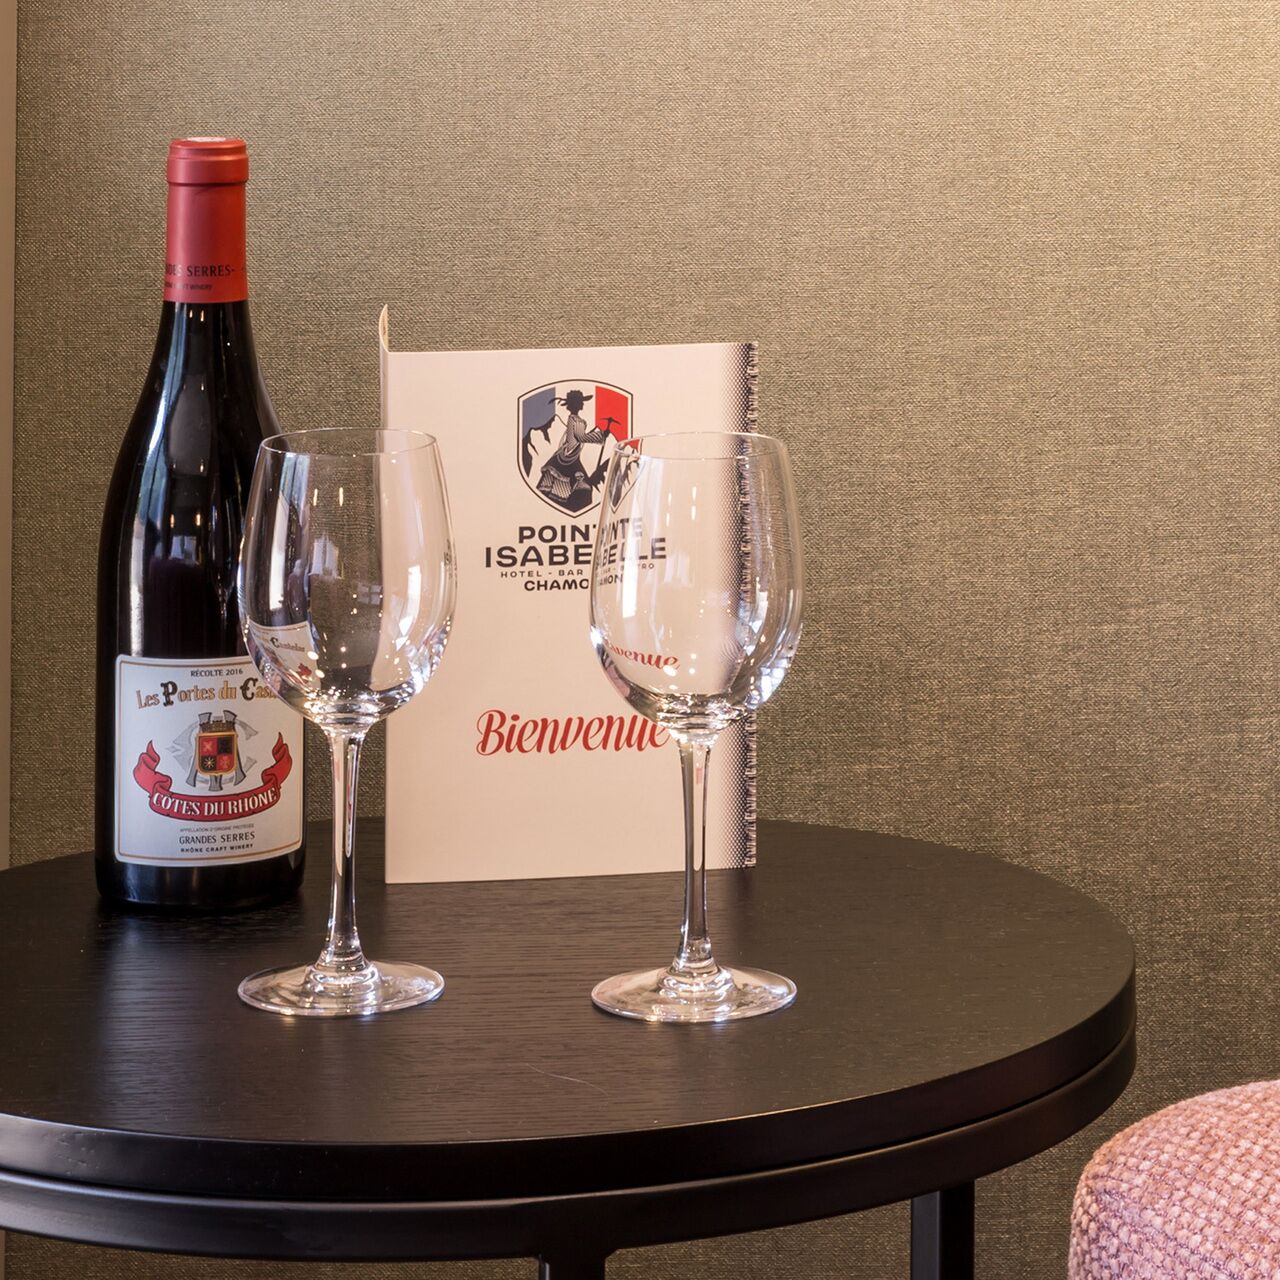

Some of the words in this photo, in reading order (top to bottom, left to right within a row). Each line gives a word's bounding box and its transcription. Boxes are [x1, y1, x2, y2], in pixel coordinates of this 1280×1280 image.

[186, 264, 232, 277] SERRES
[500, 570, 542, 579] HOTEL
[558, 568, 584, 577] BAR
[225, 668, 244, 676] 2016
[135, 689, 160, 710] Les
[160, 680, 216, 708] Portes
[217, 680, 238, 700] du
[475, 709, 673, 756] Bienvenue
[152, 792, 201, 816] CÔTES
[203, 801, 224, 816] DU
[227, 787, 278, 814] RHÔNE
[179, 834, 217, 845] GRANDES
[220, 830, 256, 843] SERRES
[229, 843, 254, 851] WINERY
